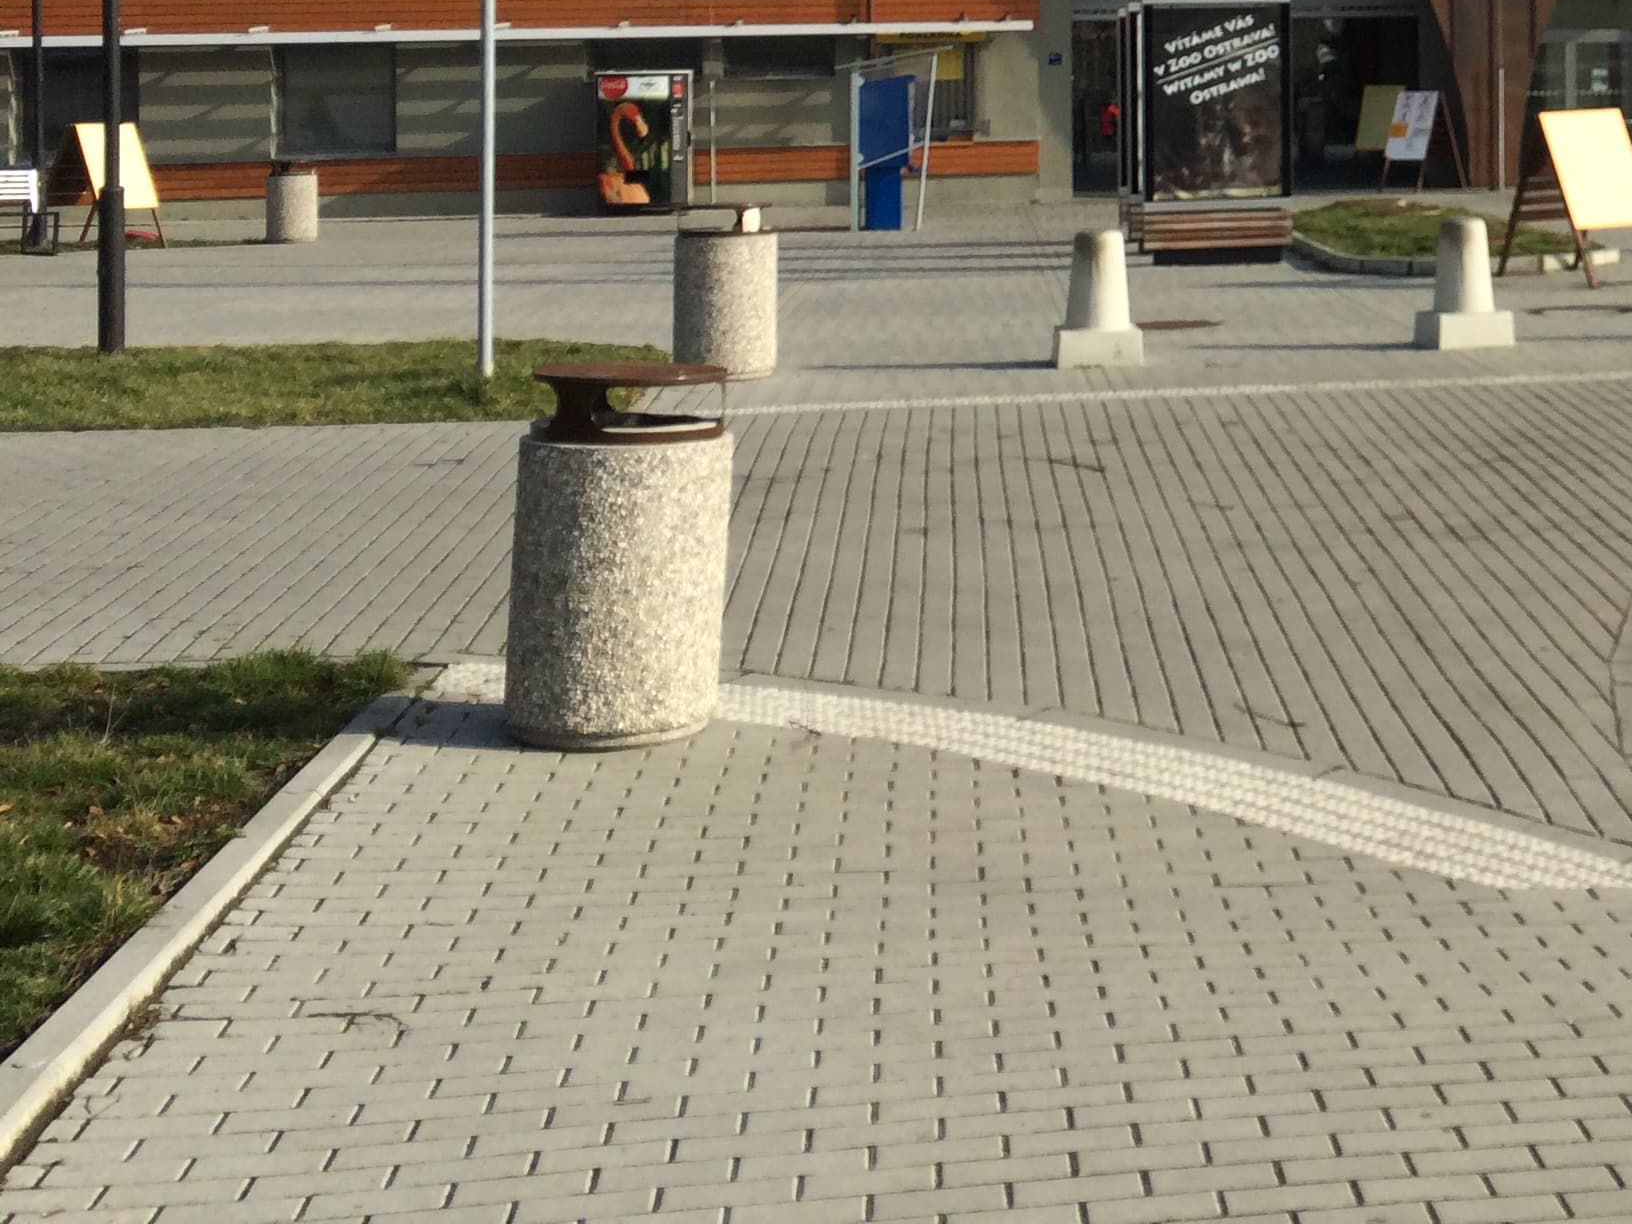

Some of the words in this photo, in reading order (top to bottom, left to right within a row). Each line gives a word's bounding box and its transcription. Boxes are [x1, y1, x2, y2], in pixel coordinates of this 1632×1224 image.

[1162, 65, 1225, 95] WITAMY
[1244, 44, 1280, 67] ZOO
[1167, 51, 1202, 73] ZOO
[1203, 23, 1276, 58] OSTRAVA!
